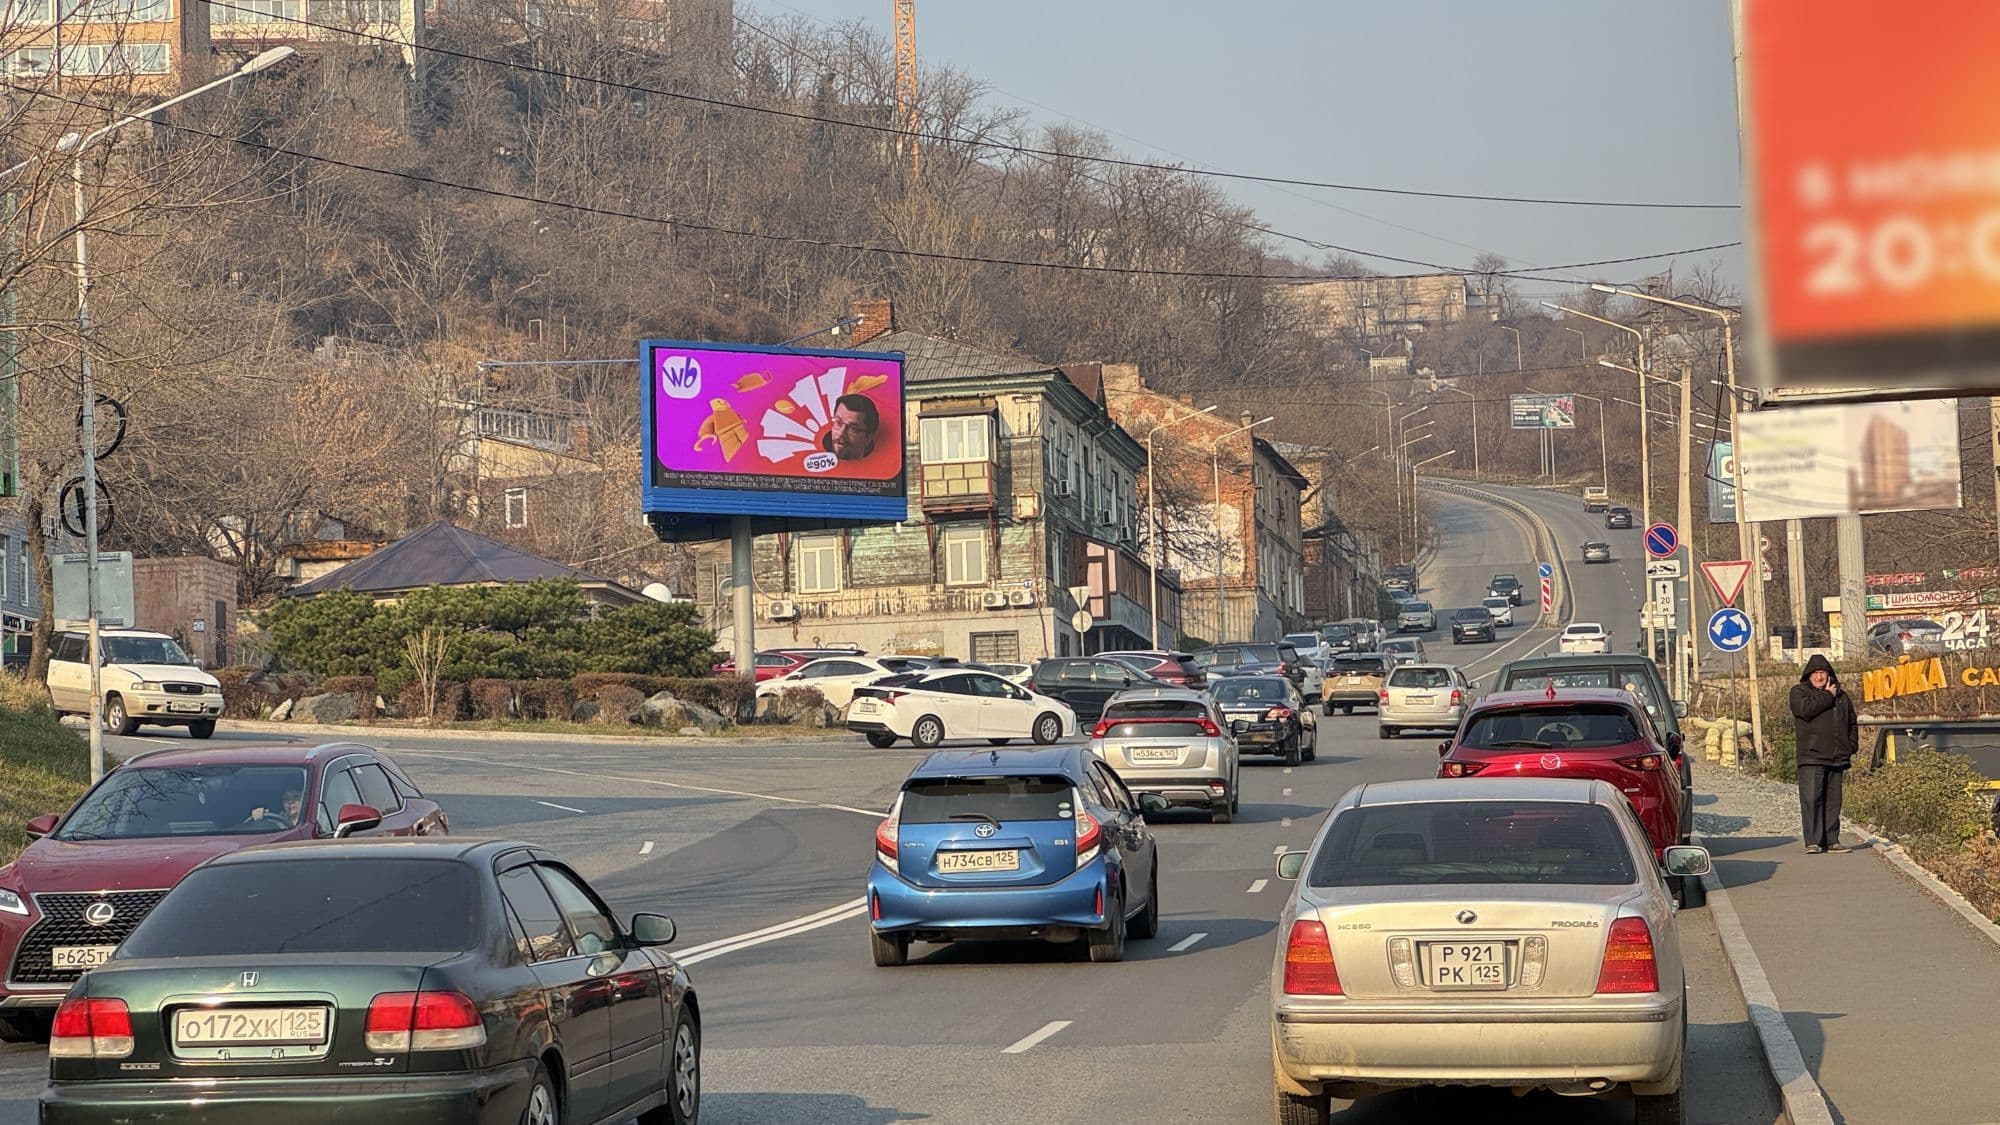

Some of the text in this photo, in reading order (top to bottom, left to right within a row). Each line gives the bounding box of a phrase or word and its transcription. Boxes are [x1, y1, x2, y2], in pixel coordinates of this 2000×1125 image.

[1660, 596, 1671, 605] 20
[1942, 608, 1990, 641] 24
[1944, 637, 1987, 651] ЧАСА
[1862, 655, 2000, 703] МОЙКА СА
[943, 851, 1014, 869] Н734СВ 125
[1461, 946, 1492, 962] 921
[1439, 965, 1500, 983] РК 125
[285, 1011, 320, 1031] 125
